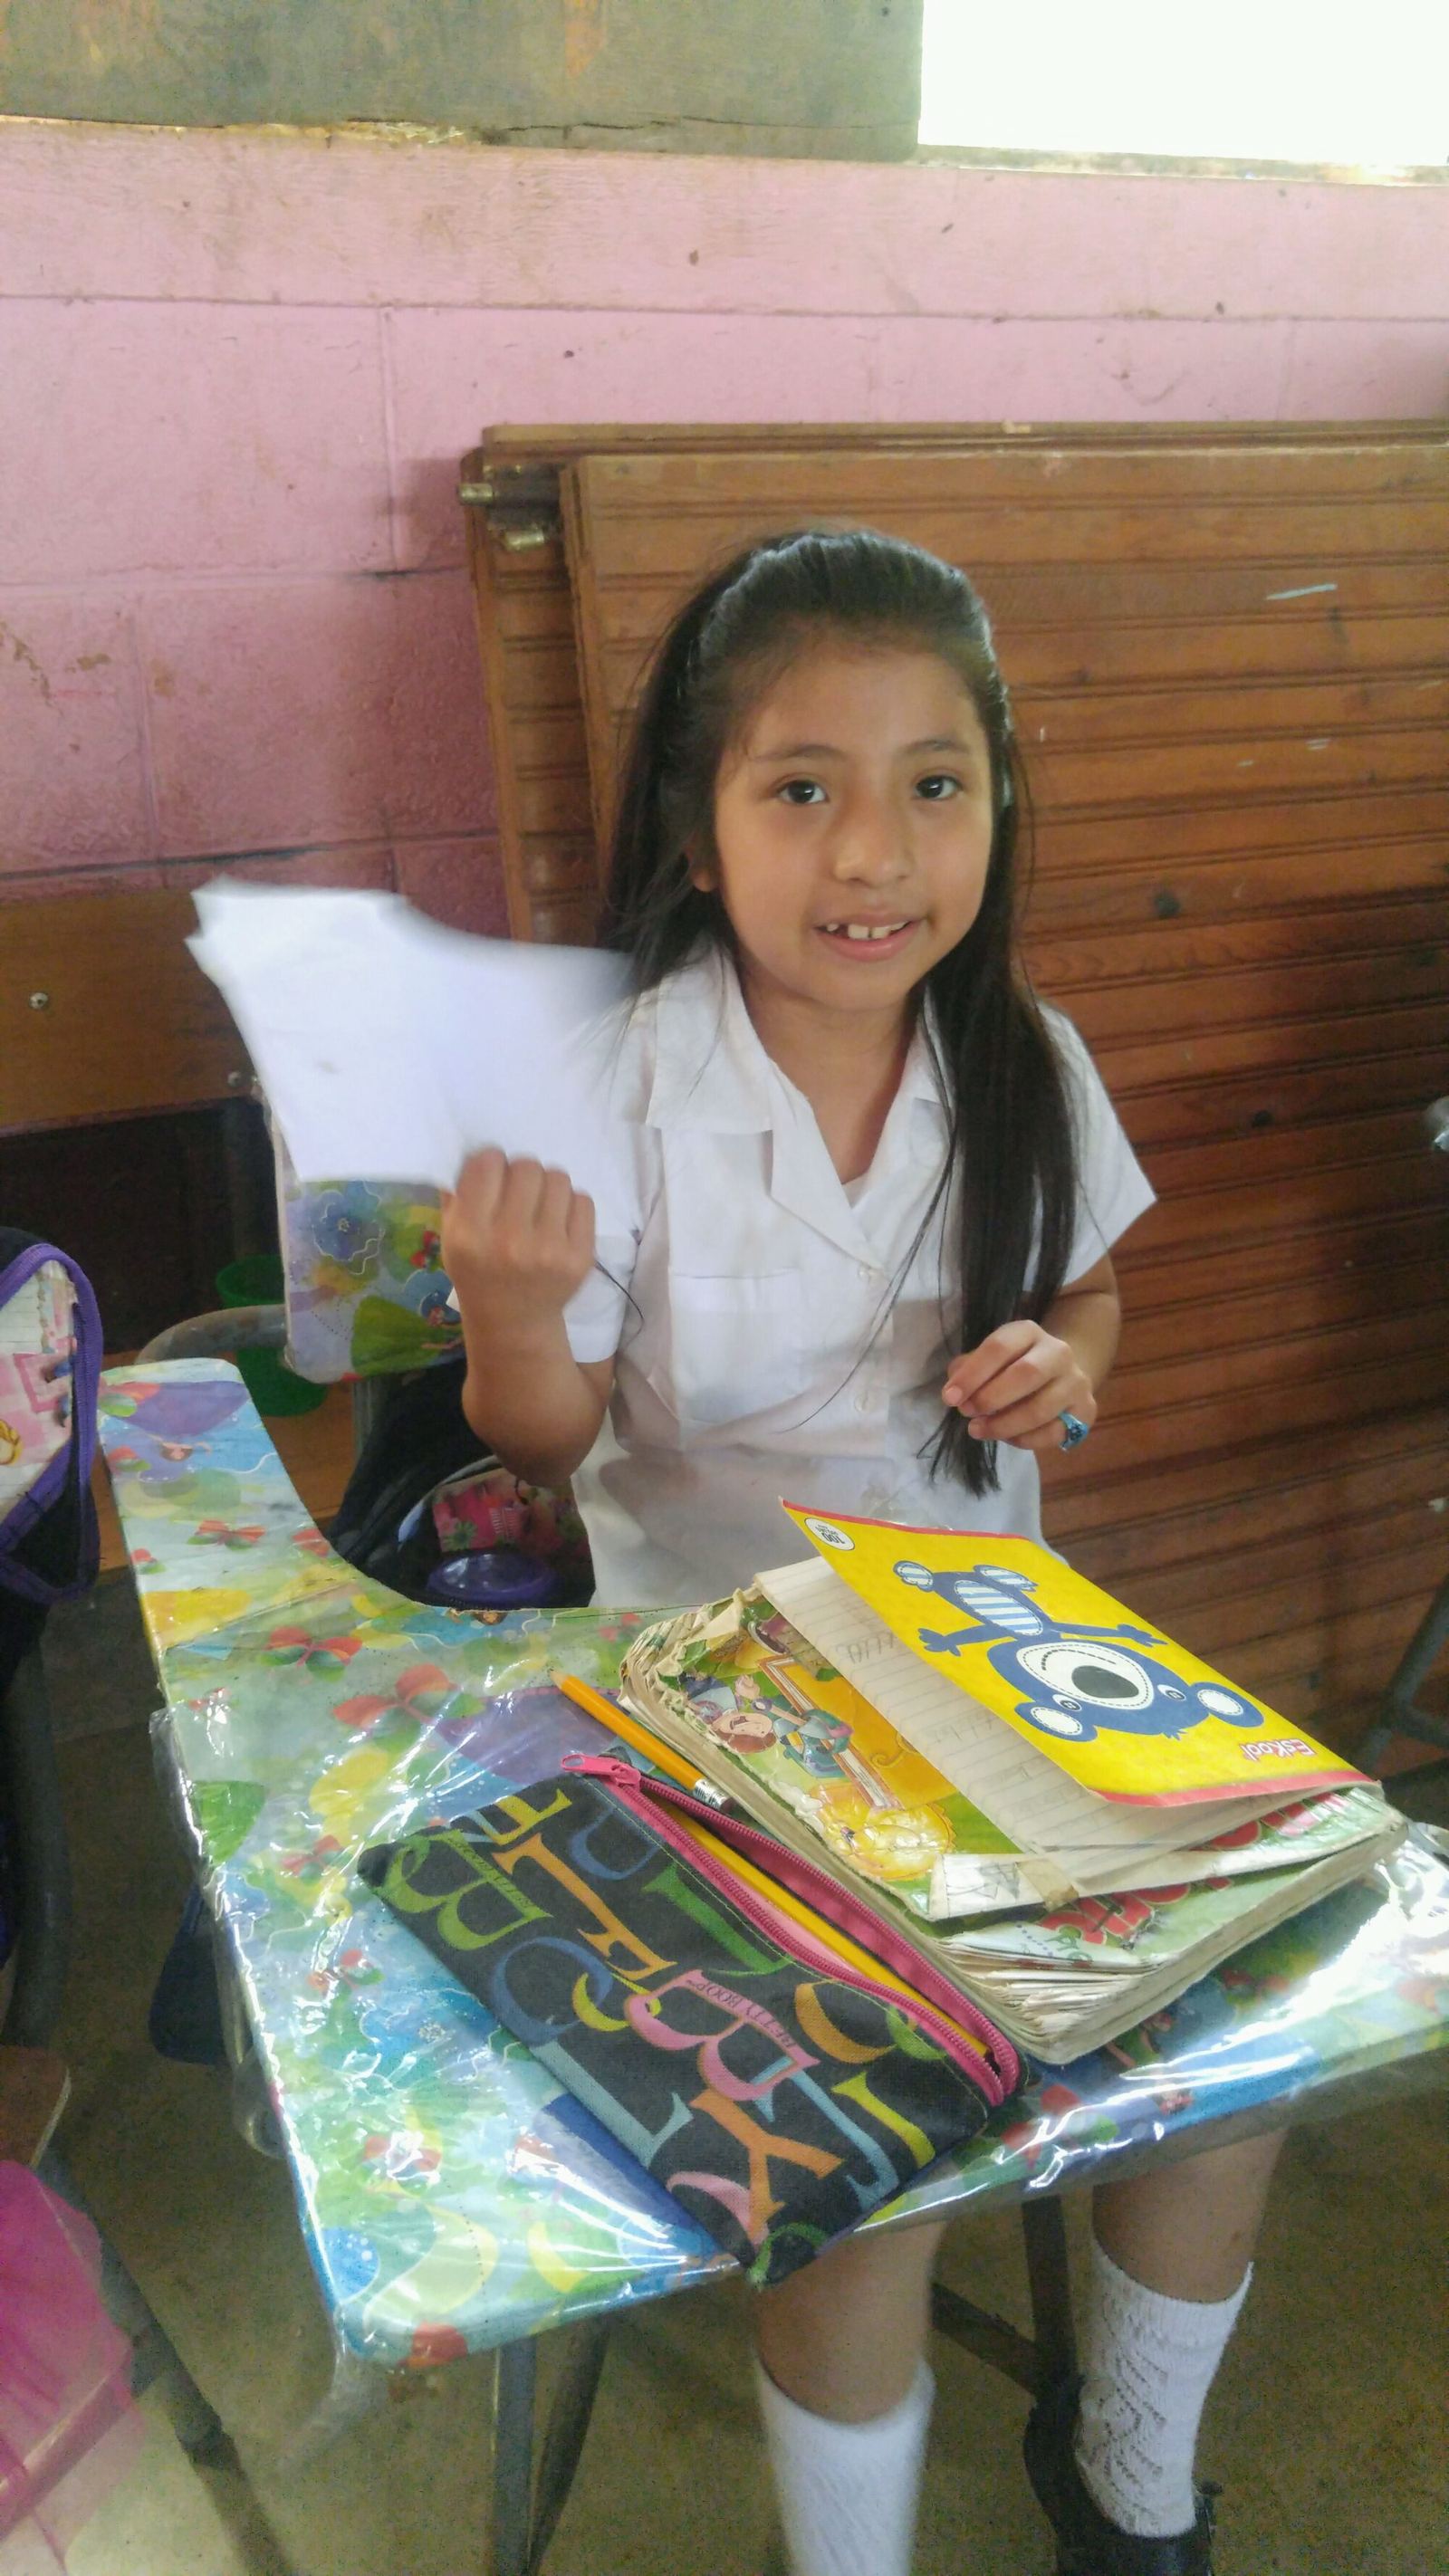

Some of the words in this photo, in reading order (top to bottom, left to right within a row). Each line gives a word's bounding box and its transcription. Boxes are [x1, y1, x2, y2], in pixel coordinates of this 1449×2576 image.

[821, 1532, 845, 1545] 100
[695, 1982, 744, 2008] BOOP
[624, 1968, 820, 2101] B
[745, 2003, 796, 2048] BETTY
